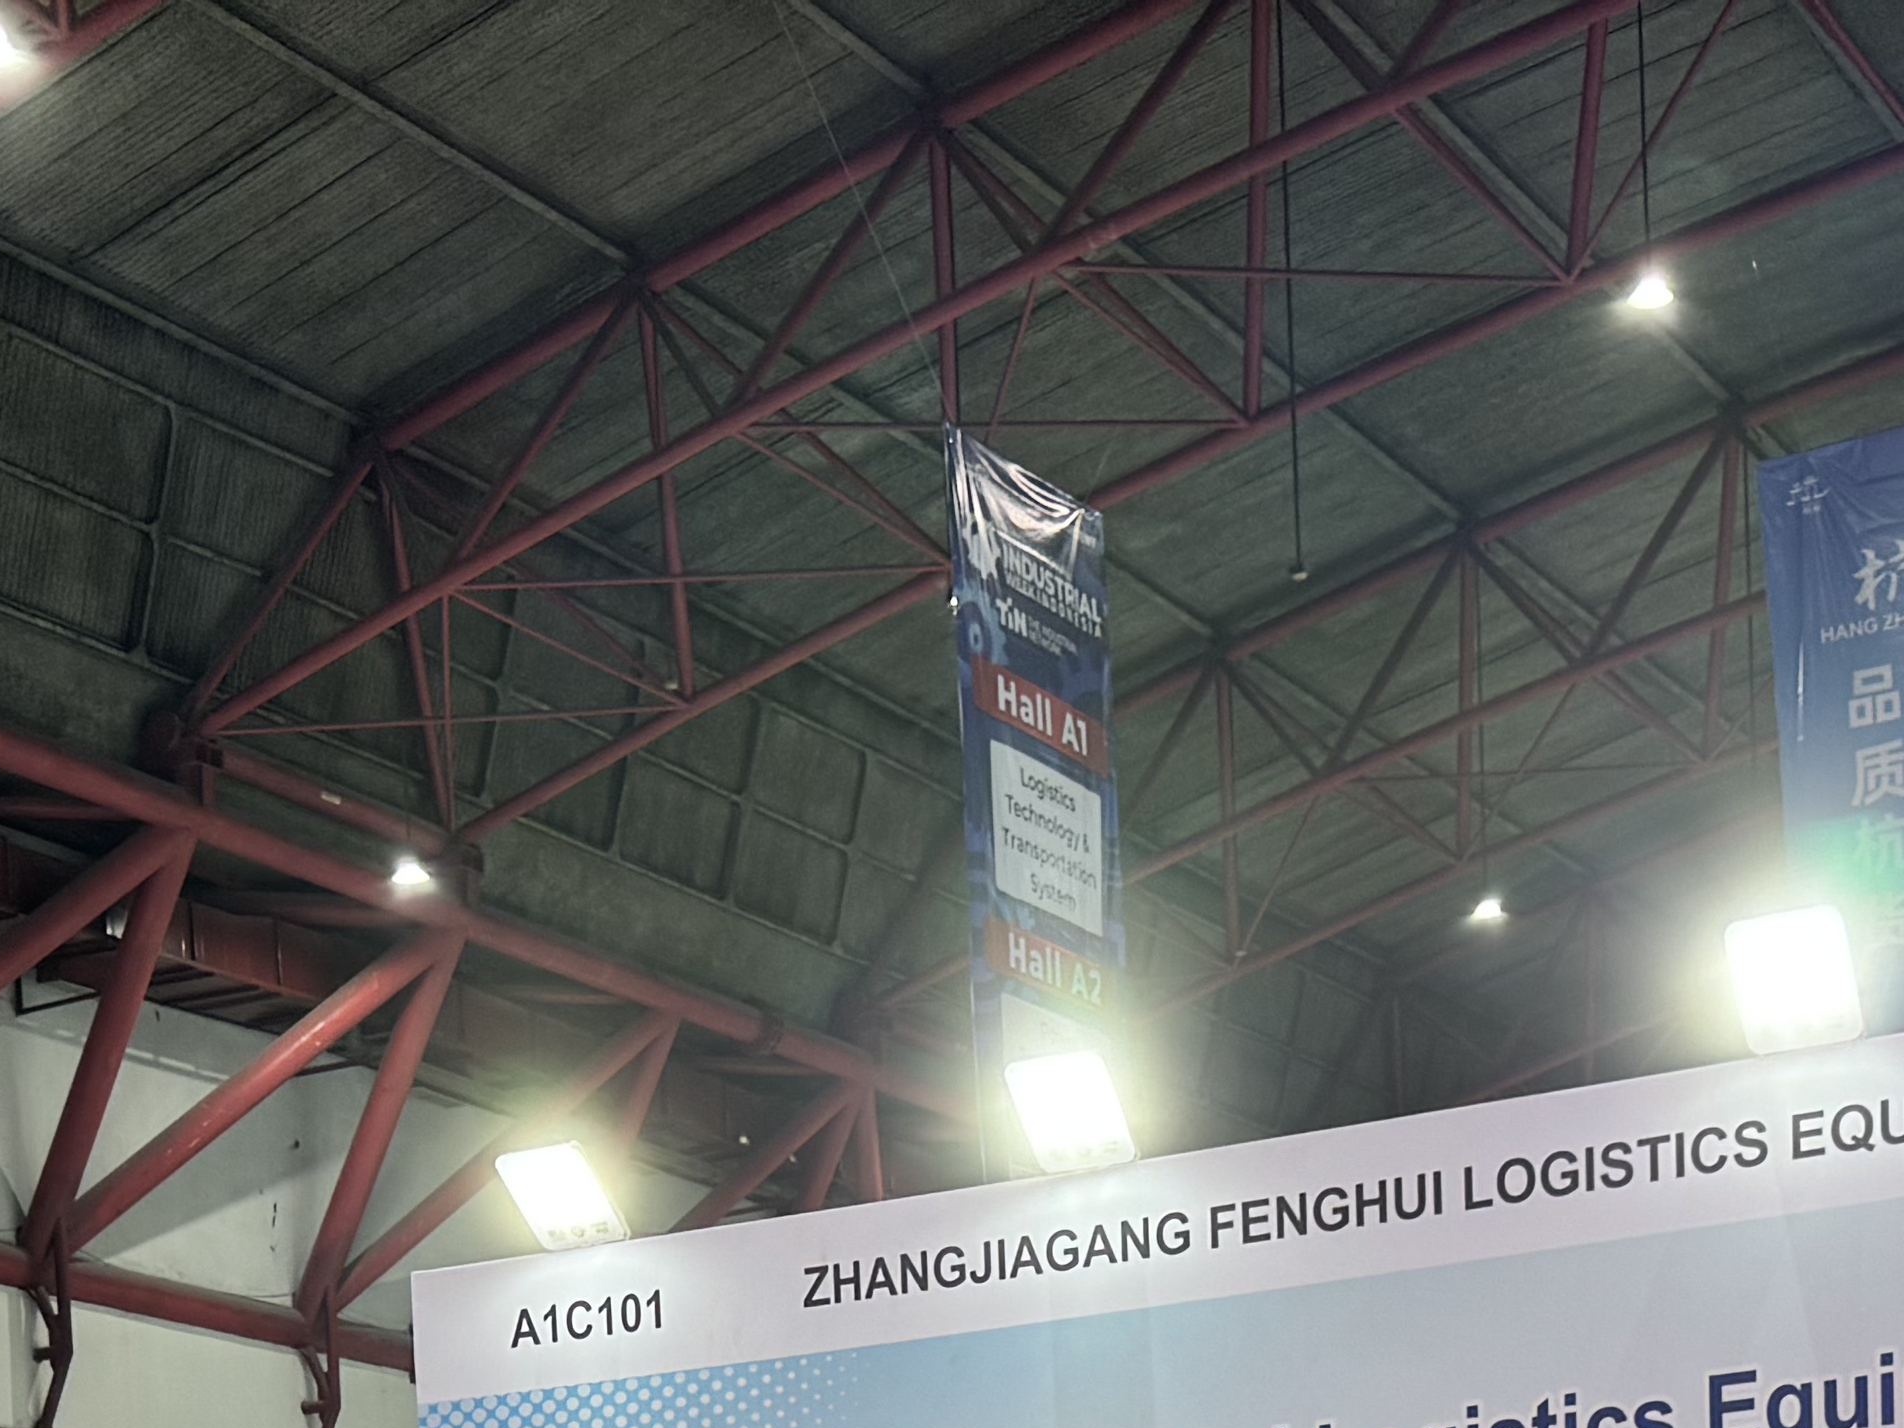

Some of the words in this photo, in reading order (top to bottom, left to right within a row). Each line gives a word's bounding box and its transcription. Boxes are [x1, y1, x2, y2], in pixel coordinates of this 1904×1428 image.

[1003, 543, 1102, 623] INDUSTRIAL
[1820, 619, 1878, 643] HANG
[997, 674, 1052, 736] Hall
[1062, 713, 1087, 756] A1
[1020, 768, 1076, 813] Logistics
[1005, 795, 1079, 851] Technology
[1082, 833, 1089, 853] &
[1001, 828, 1096, 890] Transportation
[1030, 874, 1076, 911] System
[1008, 933, 1061, 988] Hall
[1072, 965, 1102, 1005] A2
[511, 1289, 664, 1348] A1C101
[802, 1212, 1192, 1309] ZHANGJIAGANG
[1209, 1171, 1444, 1249] FENGHUI
[1463, 1119, 1769, 1211] LOGISTICS
